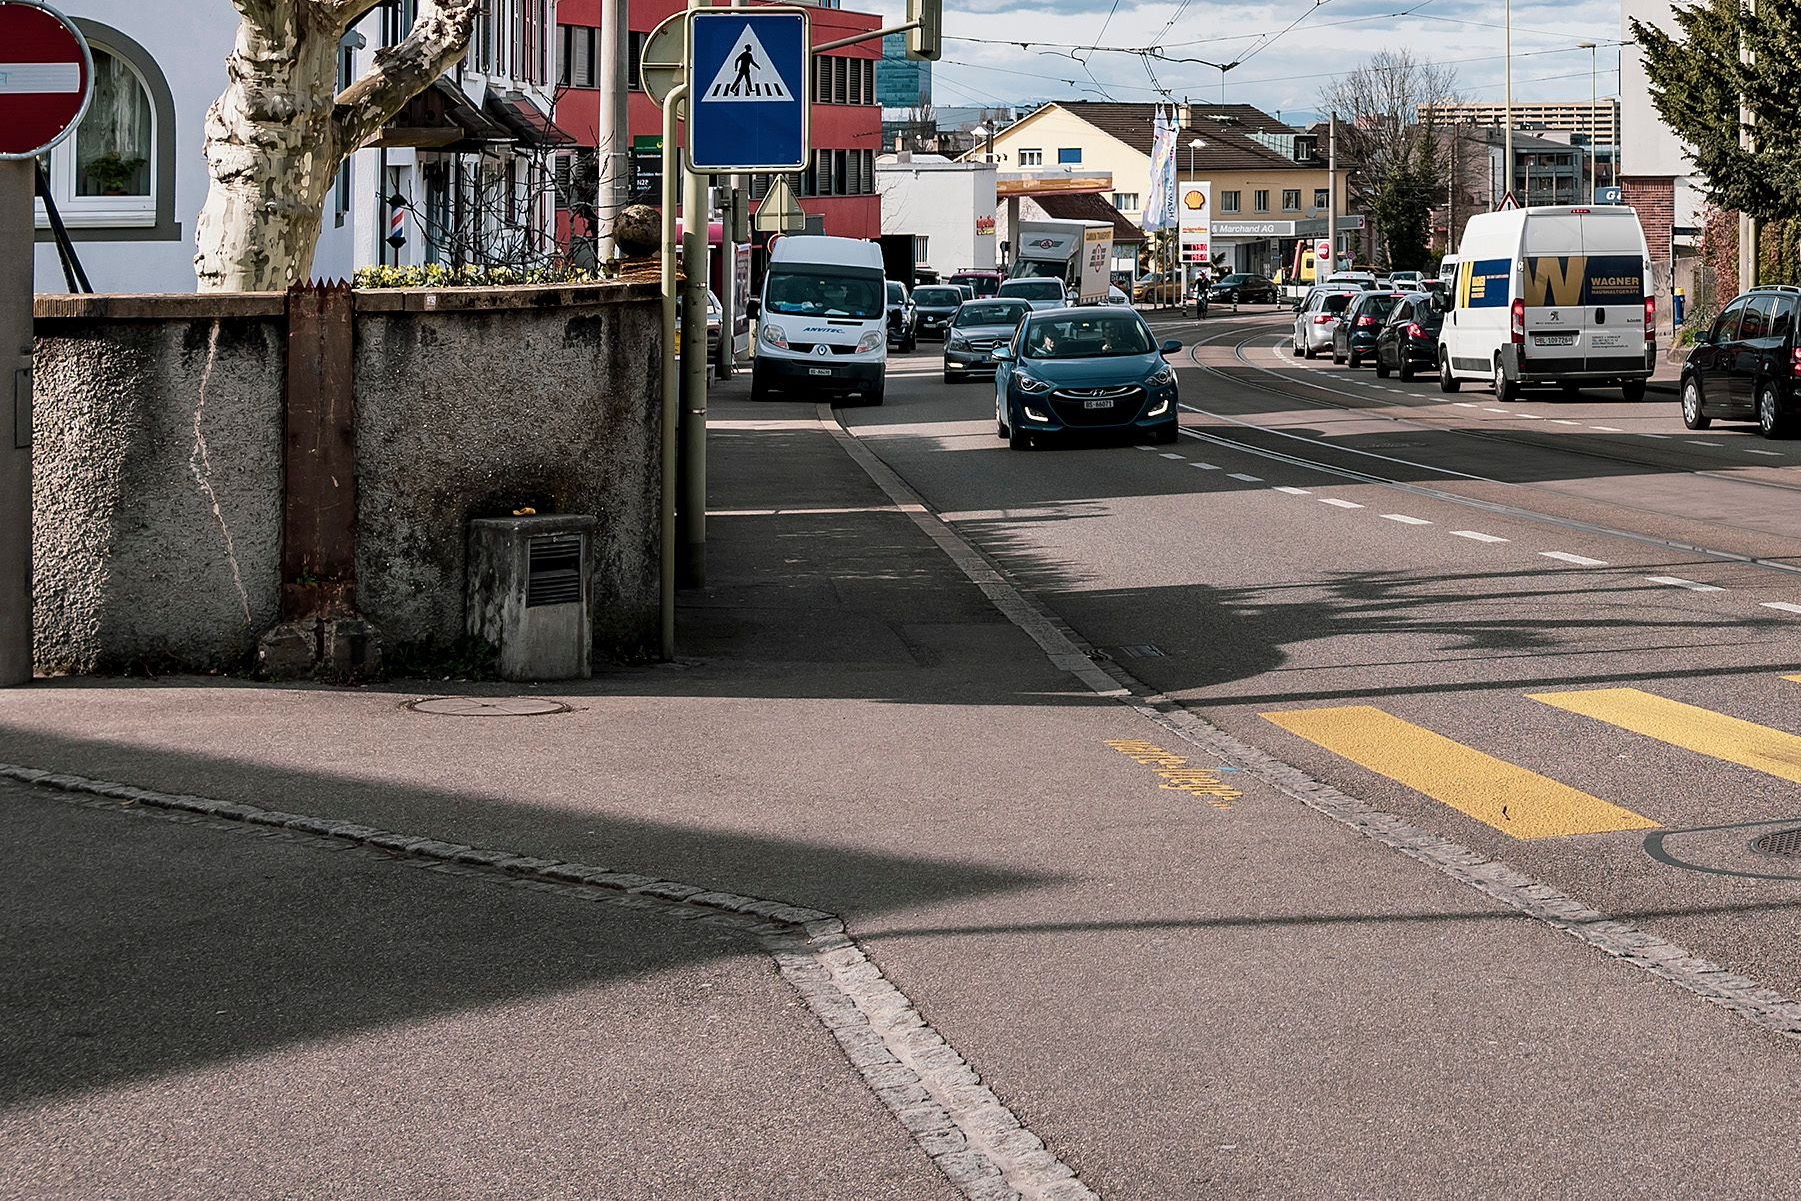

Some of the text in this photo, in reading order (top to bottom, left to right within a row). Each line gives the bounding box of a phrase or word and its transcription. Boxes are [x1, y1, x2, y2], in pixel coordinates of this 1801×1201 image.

[1219, 224, 1260, 233] Marchand
[1261, 225, 1274, 233] AG
[1591, 277, 1639, 286] WAGNER
